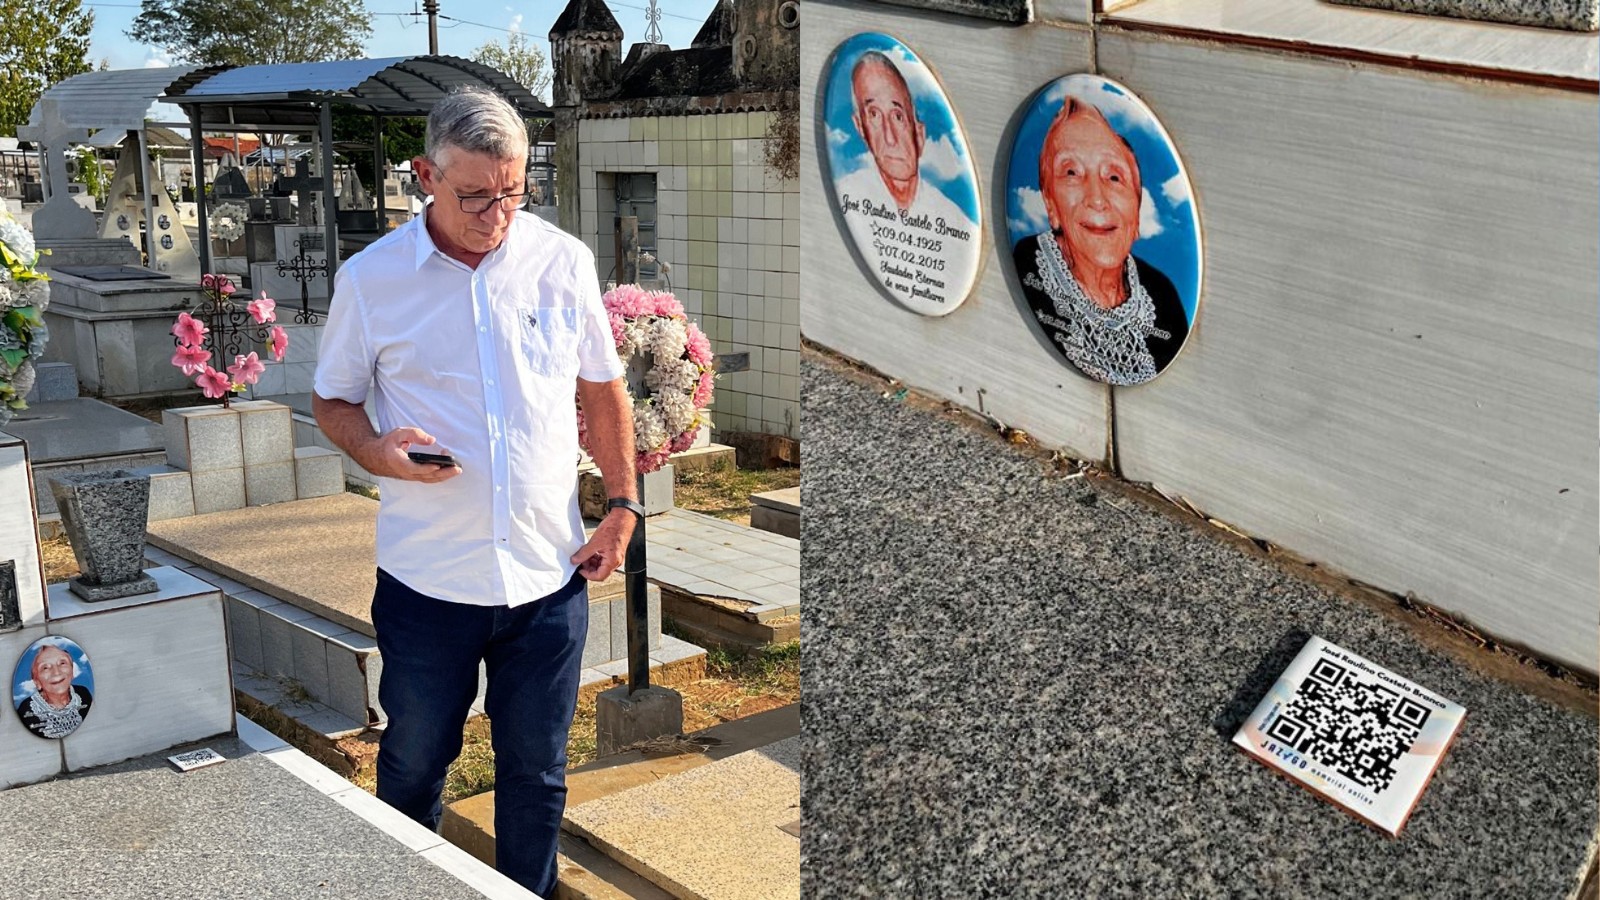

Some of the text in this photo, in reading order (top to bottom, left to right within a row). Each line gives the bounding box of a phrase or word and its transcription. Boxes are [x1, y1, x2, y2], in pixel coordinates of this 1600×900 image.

[841, 194, 971, 242] José Raulino Castelo Branco
[882, 226, 942, 252] 09.04.1925
[885, 246, 946, 271] 07.02.2015
[1321, 645, 1447, 710] José Raulino Castelo Branco
